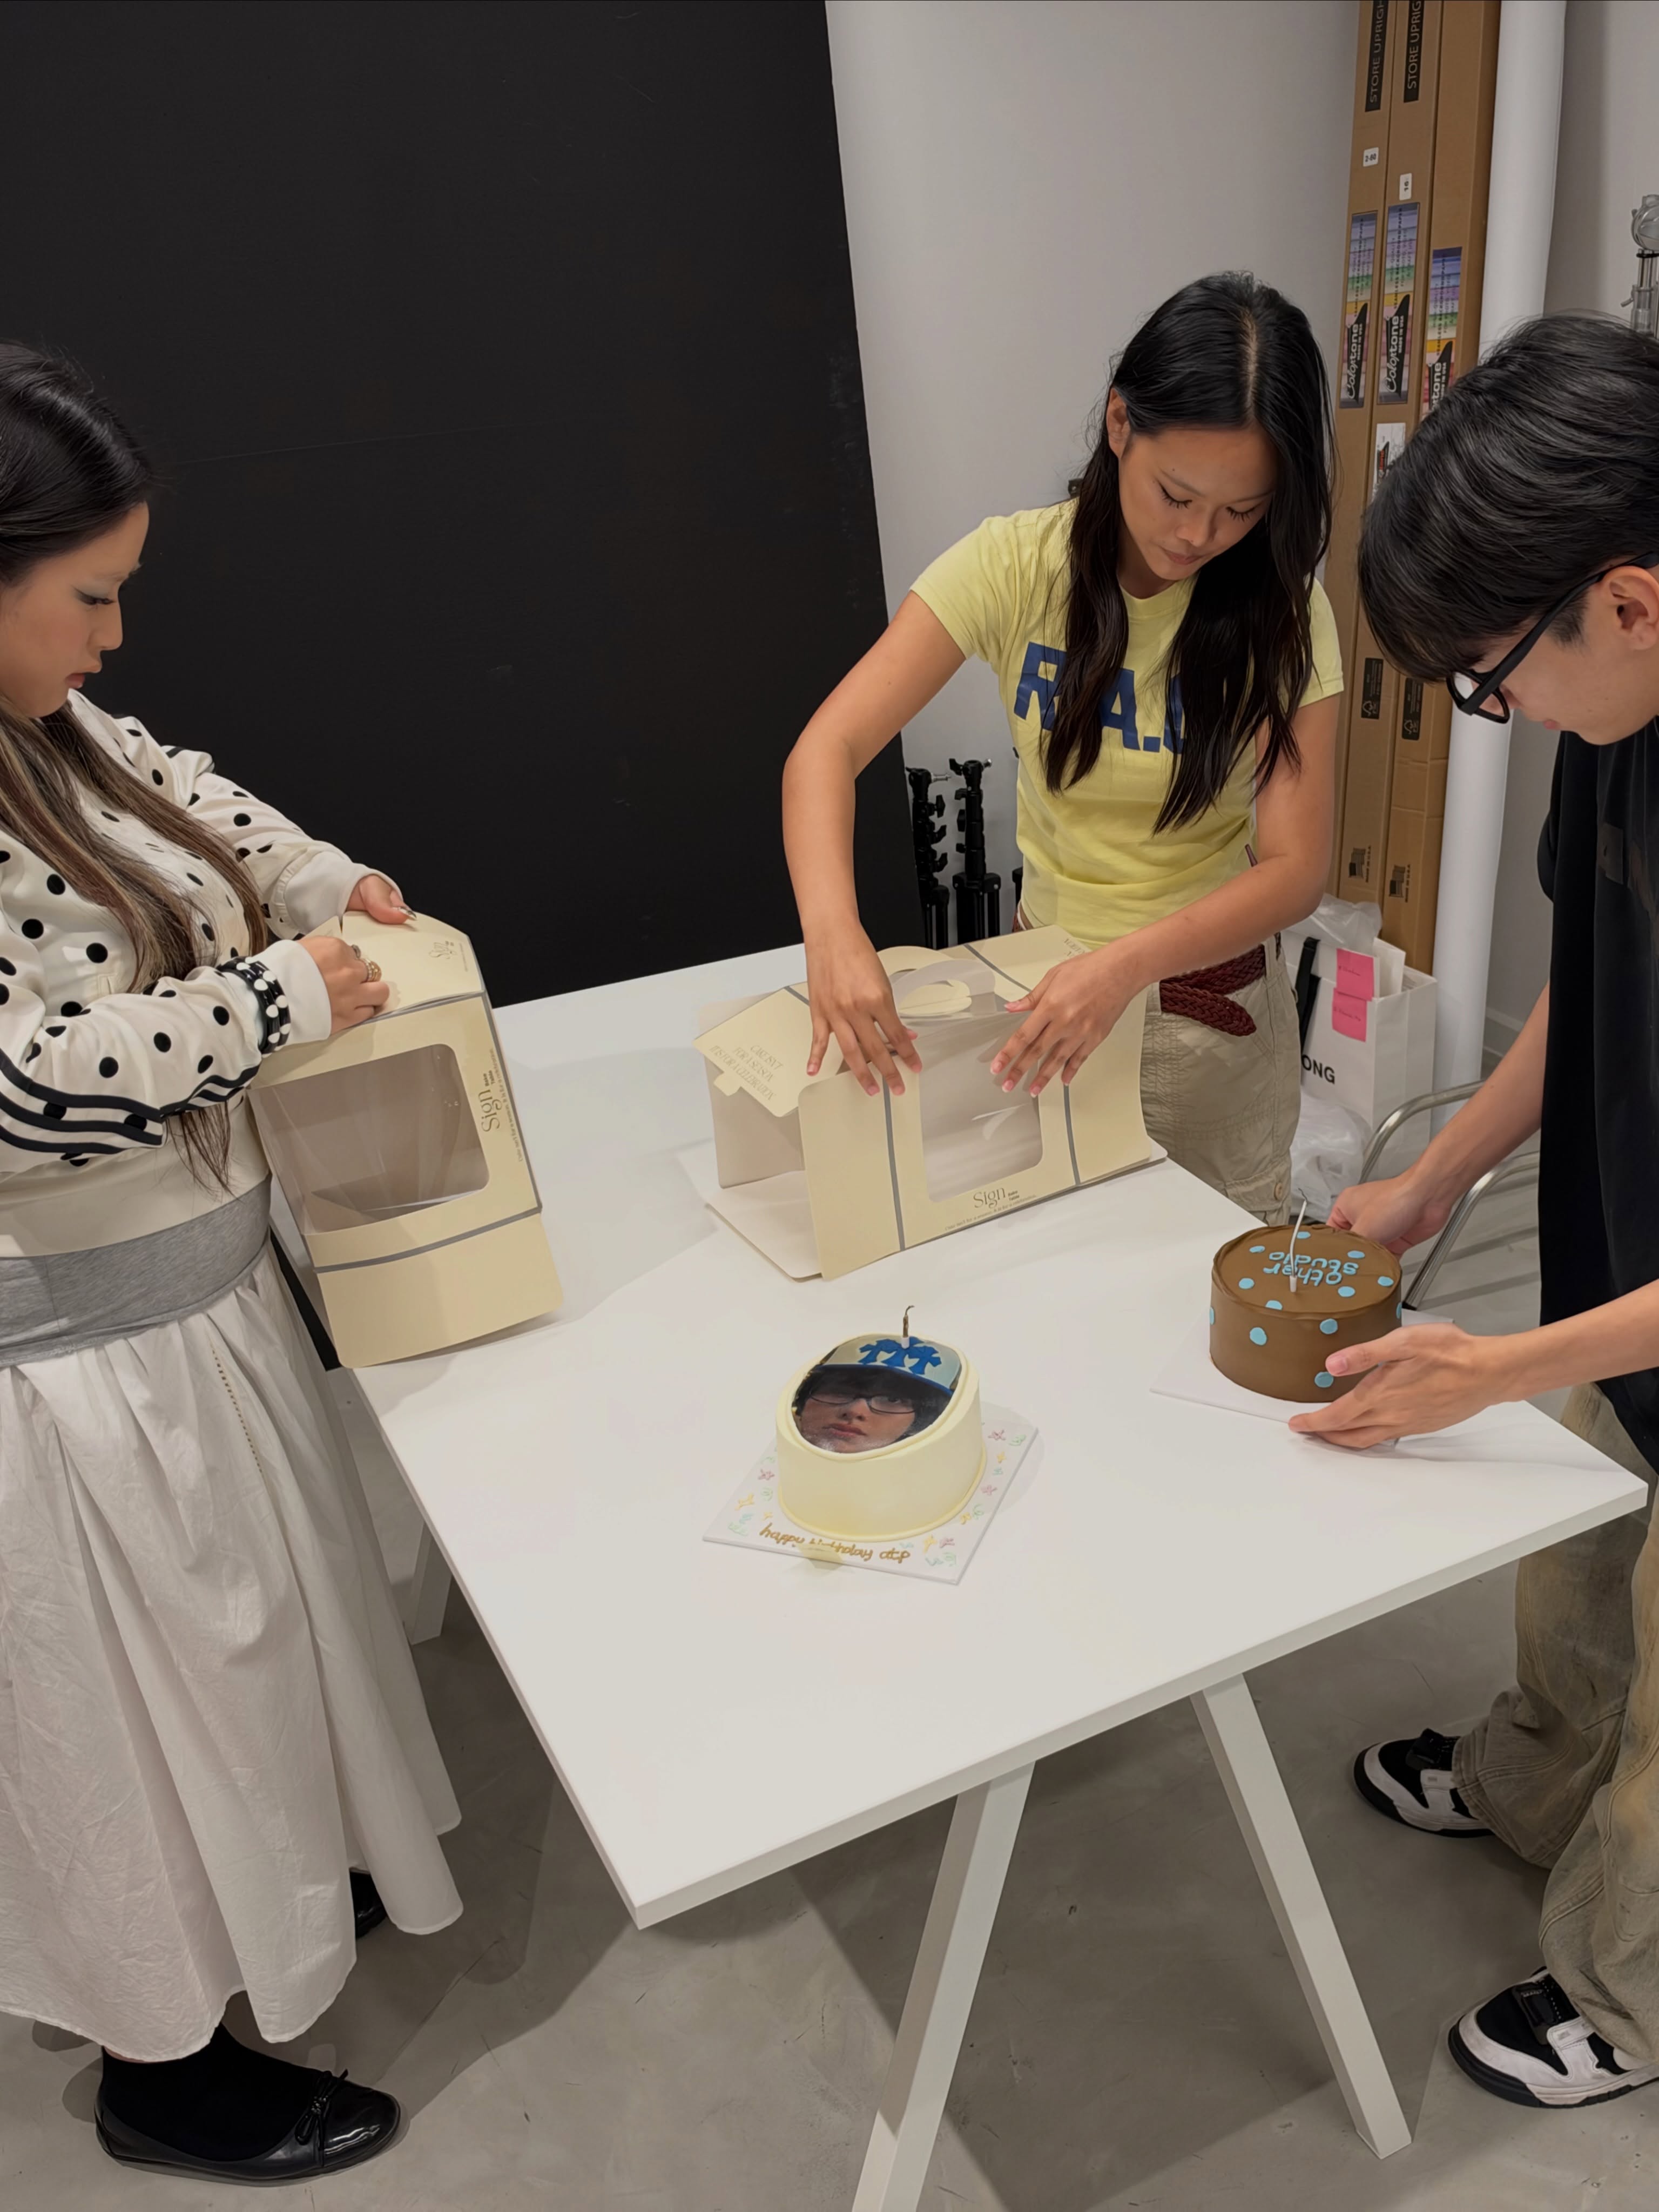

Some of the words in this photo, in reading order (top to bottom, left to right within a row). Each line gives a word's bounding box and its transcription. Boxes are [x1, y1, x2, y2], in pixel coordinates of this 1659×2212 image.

[1370, 56, 1380, 103] STORE
[1407, 45, 1419, 89] STORE
[488, 1070, 496, 1084] Table
[478, 1089, 502, 1132] Sign
[973, 1188, 1006, 1209] Sign
[1269, 1252, 1359, 1275] studio
